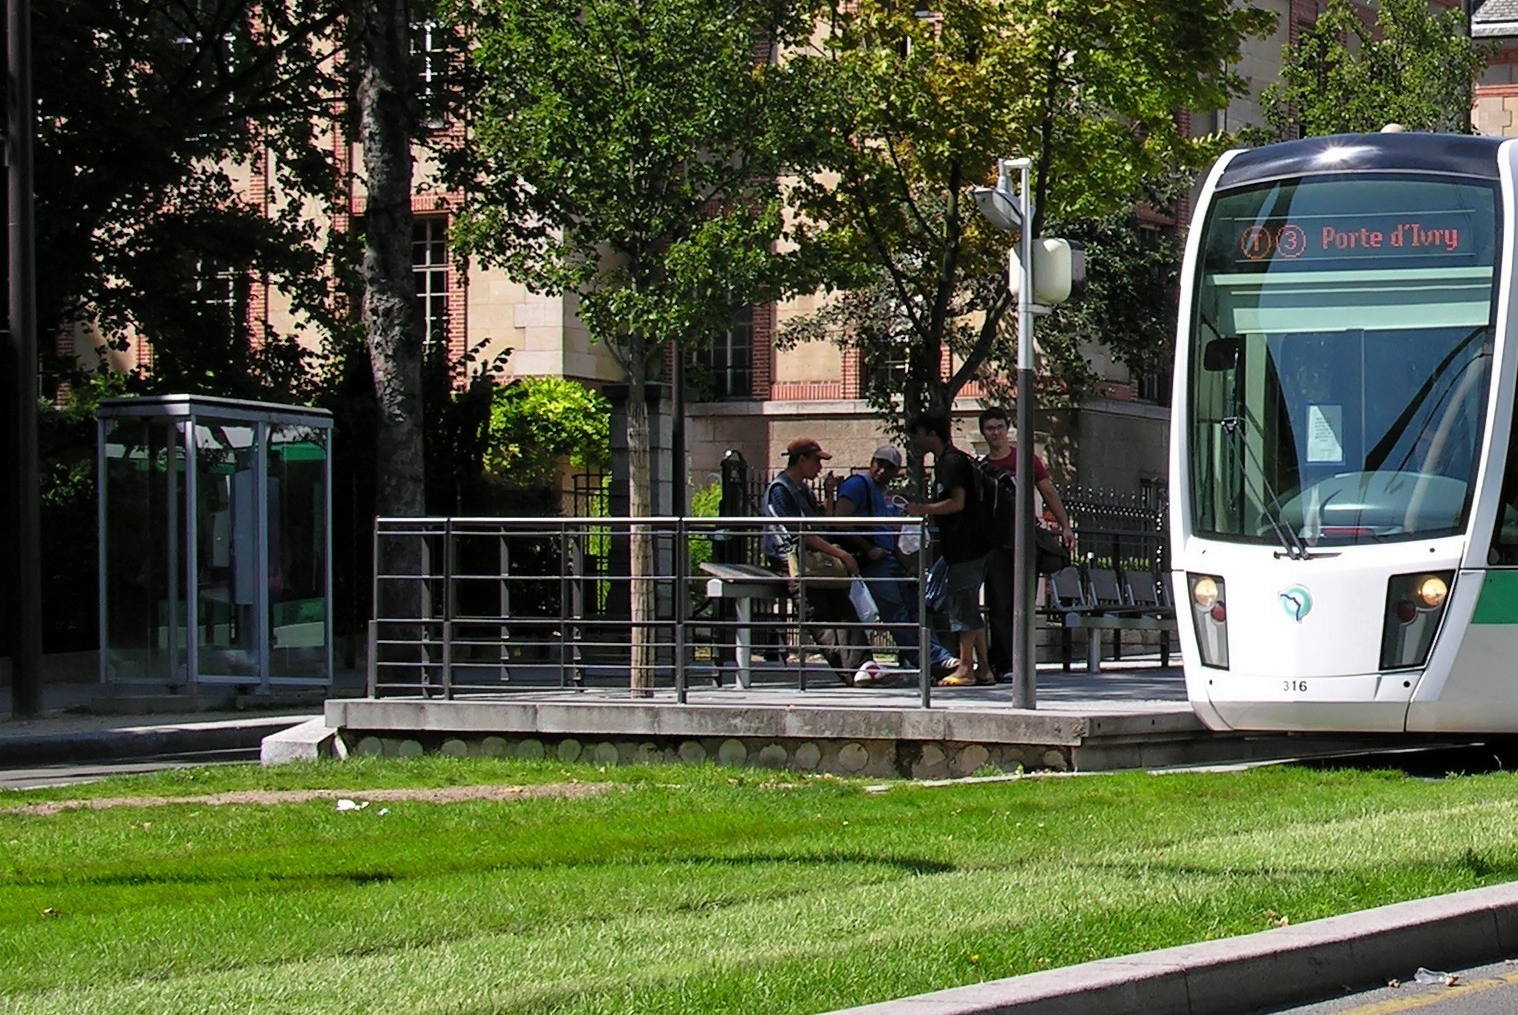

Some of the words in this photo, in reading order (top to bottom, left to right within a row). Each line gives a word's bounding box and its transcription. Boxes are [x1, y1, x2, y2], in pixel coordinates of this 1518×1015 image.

[1322, 226, 1383, 250] Porte
[1390, 223, 1458, 251] d'Ivry
[1283, 680, 1307, 692] 316
